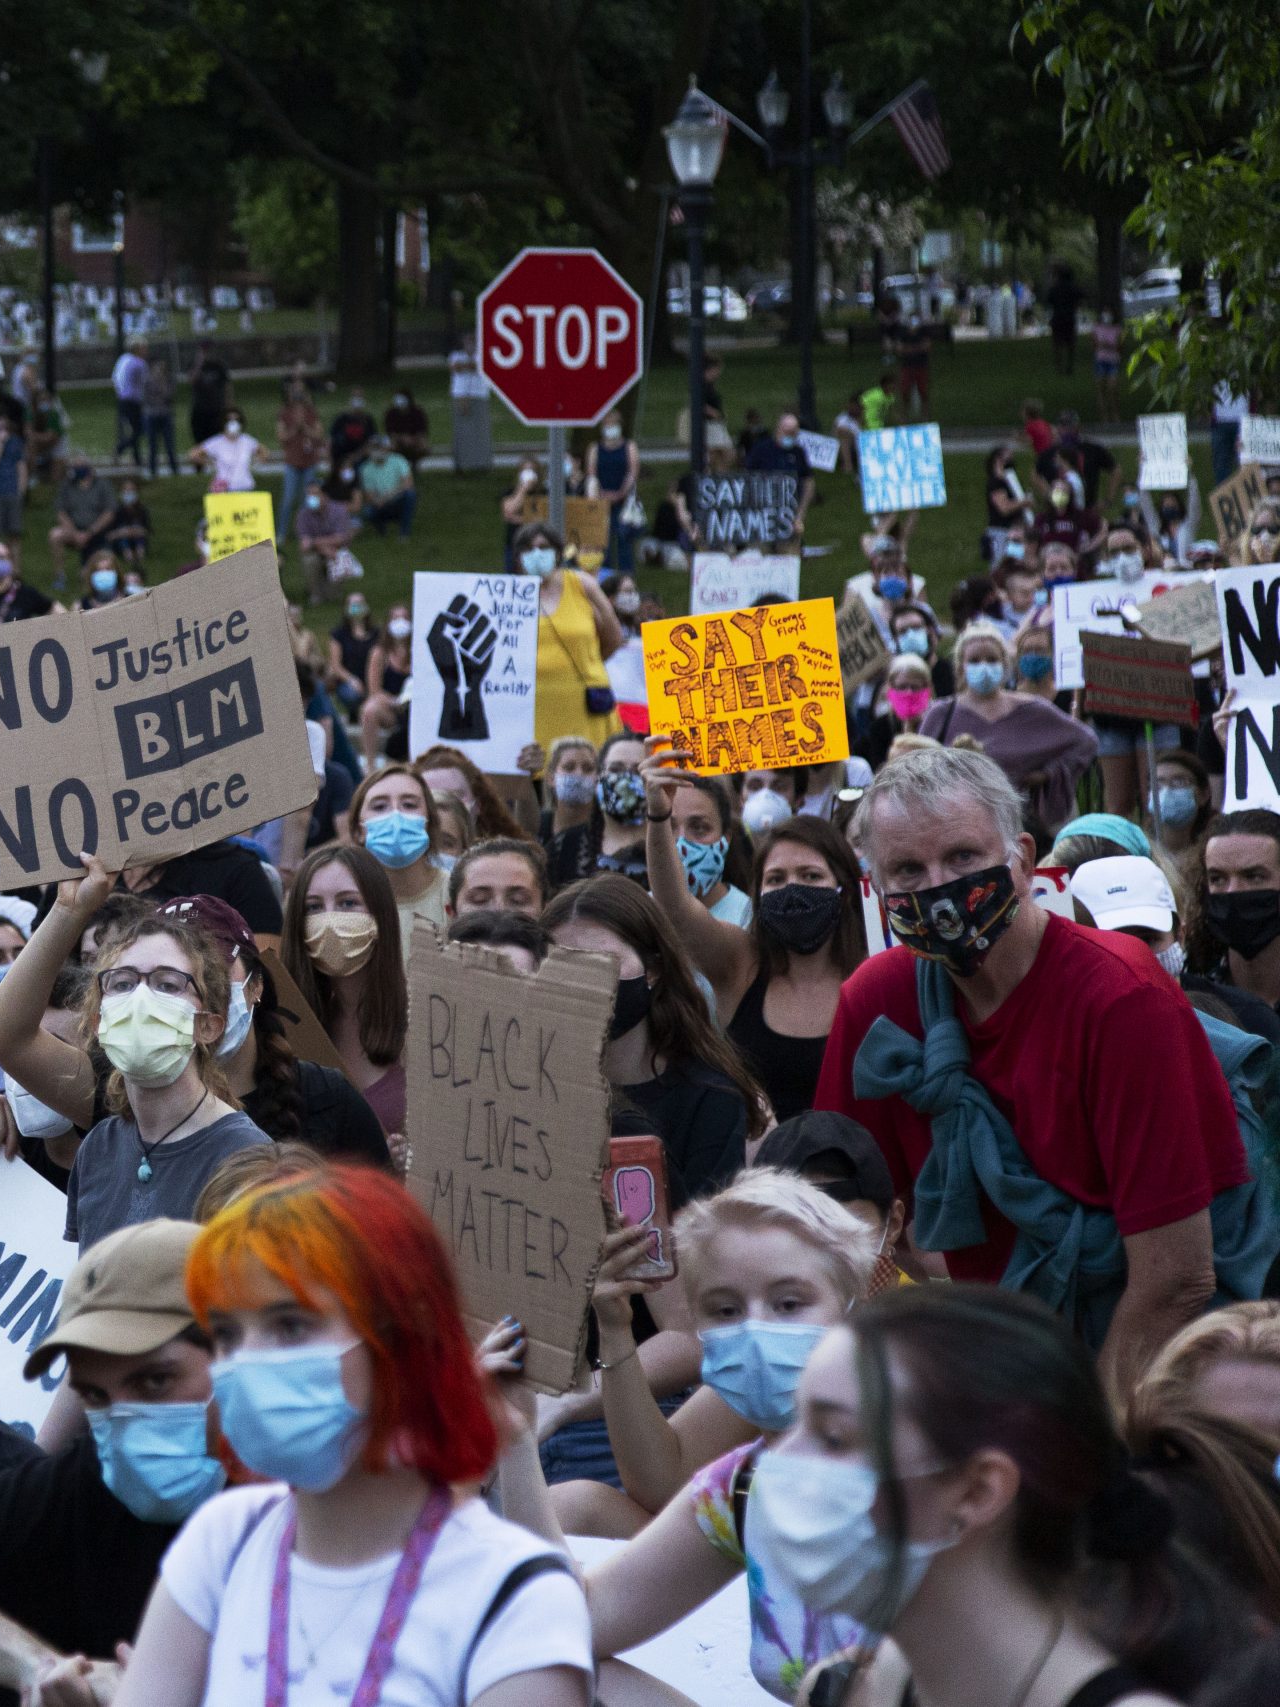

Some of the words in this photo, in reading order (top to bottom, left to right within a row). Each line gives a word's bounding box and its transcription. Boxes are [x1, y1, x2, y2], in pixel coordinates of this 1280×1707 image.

[490, 304, 631, 370] STOP
[698, 476, 745, 509] SAY
[706, 505, 795, 543] NAMES
[473, 578, 536, 601] Make
[769, 613, 807, 627] George
[92, 609, 250, 692] Justice
[670, 608, 769, 676] SAY
[777, 619, 807, 637] Floyd
[484, 681, 532, 697] Reality
[503, 655, 516, 675] A
[663, 654, 809, 720] THEIR
[802, 654, 834, 671] Taylor
[134, 680, 250, 764] BLM
[670, 702, 826, 770] NAMES
[762, 758, 792, 769] many
[112, 773, 250, 843] Peace
[428, 994, 559, 1102] BLACK
[465, 1099, 553, 1182] LIVES
[432, 1169, 573, 1288] MATTER
